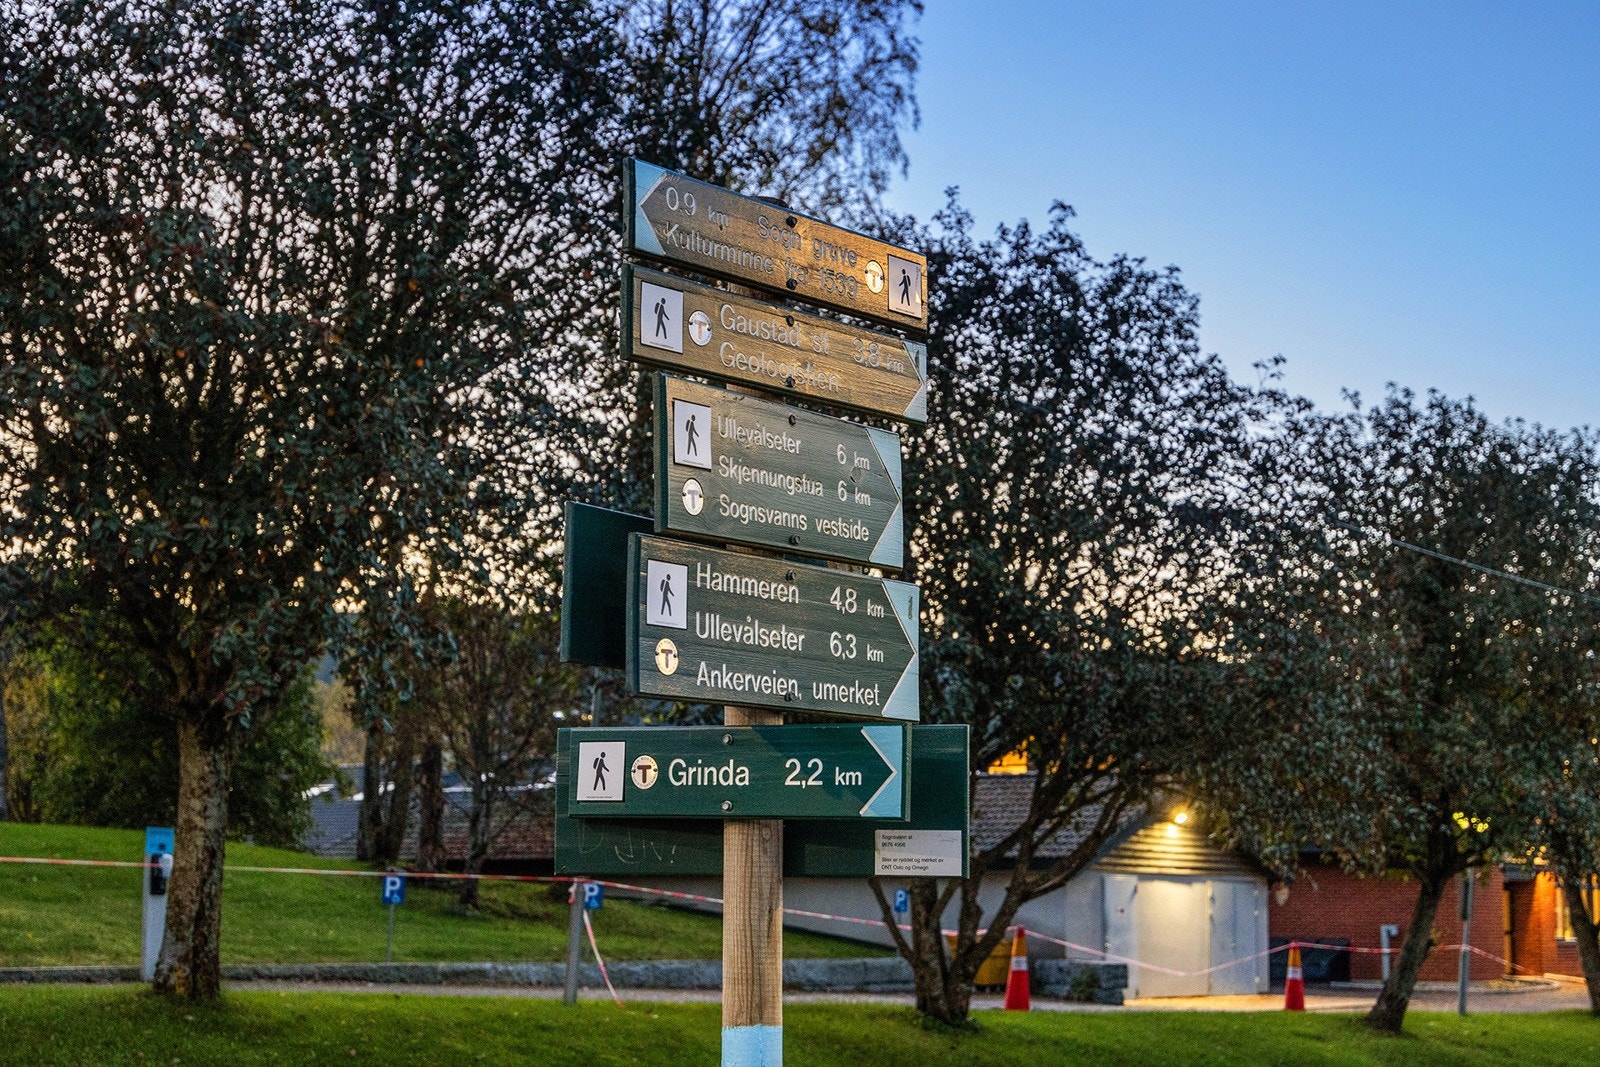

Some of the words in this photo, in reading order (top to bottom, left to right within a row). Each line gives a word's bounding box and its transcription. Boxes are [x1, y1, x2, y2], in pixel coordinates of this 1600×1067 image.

[665, 221, 774, 275] Kulturminne
[785, 257, 808, 285] fra
[817, 267, 858, 300] 1539
[708, 205, 729, 227] km
[757, 214, 802, 251] Sogn
[813, 238, 858, 267] gruve
[720, 304, 801, 347] Gaustad
[886, 356, 904, 374] km
[720, 341, 840, 393] Geologistien
[718, 416, 801, 455] Ullevålseter
[837, 443, 847, 465] 6
[854, 452, 870, 471] km
[718, 455, 823, 498] Skjennungstua
[837, 480, 848, 502] 6
[855, 487, 871, 507] km
[719, 494, 808, 531] Sognsvanns
[815, 517, 870, 542] vestside
[696, 562, 800, 604] Hammeren
[829, 586, 858, 614] 4,8
[867, 599, 884, 618] km
[696, 611, 806, 652] Ullevålseter
[829, 631, 857, 659] 6,3
[867, 645, 884, 663] km
[812, 683, 880, 706] umerket
[668, 758, 750, 786] Grinda
[784, 758, 824, 789] 2,2
[834, 765, 863, 786] km
[385, 876, 400, 898] P
[583, 883, 598, 902] P
